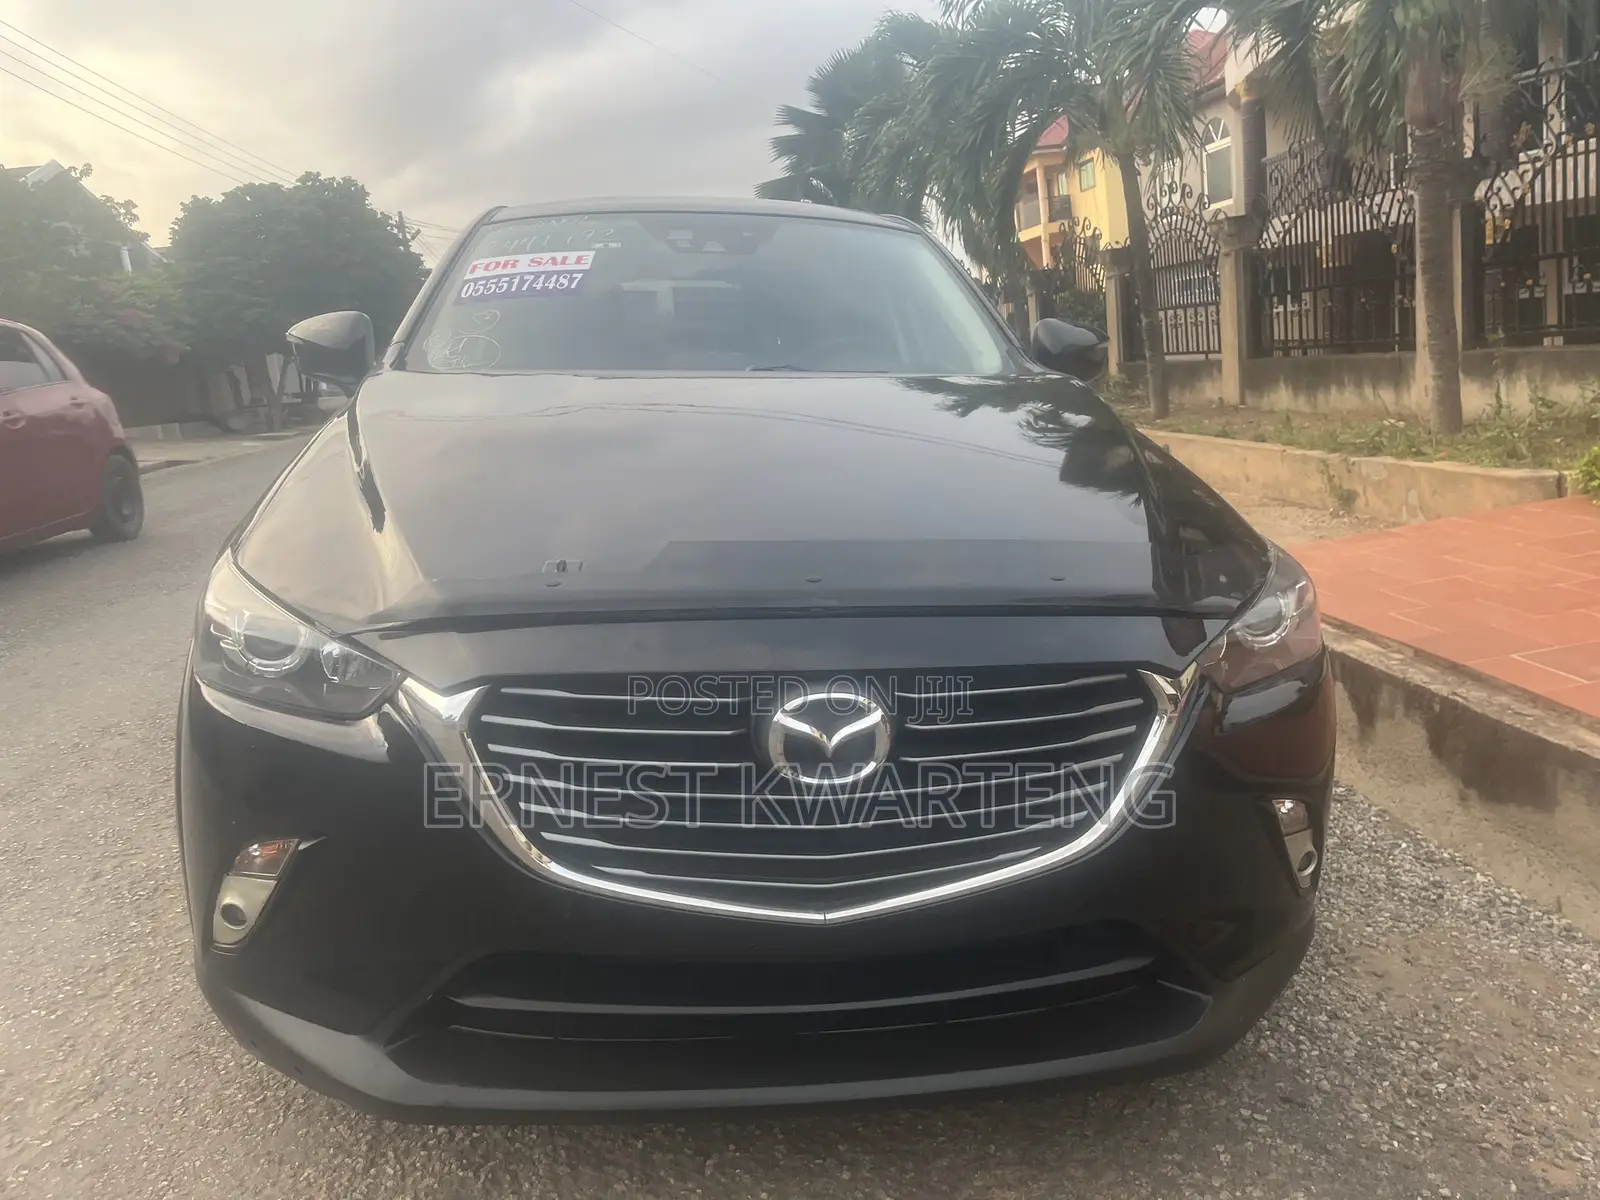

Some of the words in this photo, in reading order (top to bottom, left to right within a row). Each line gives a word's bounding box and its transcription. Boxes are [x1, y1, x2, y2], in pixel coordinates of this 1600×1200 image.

[470, 259, 520, 274] FOR
[527, 255, 590, 268] SALE
[460, 273, 583, 298] 0555174487
